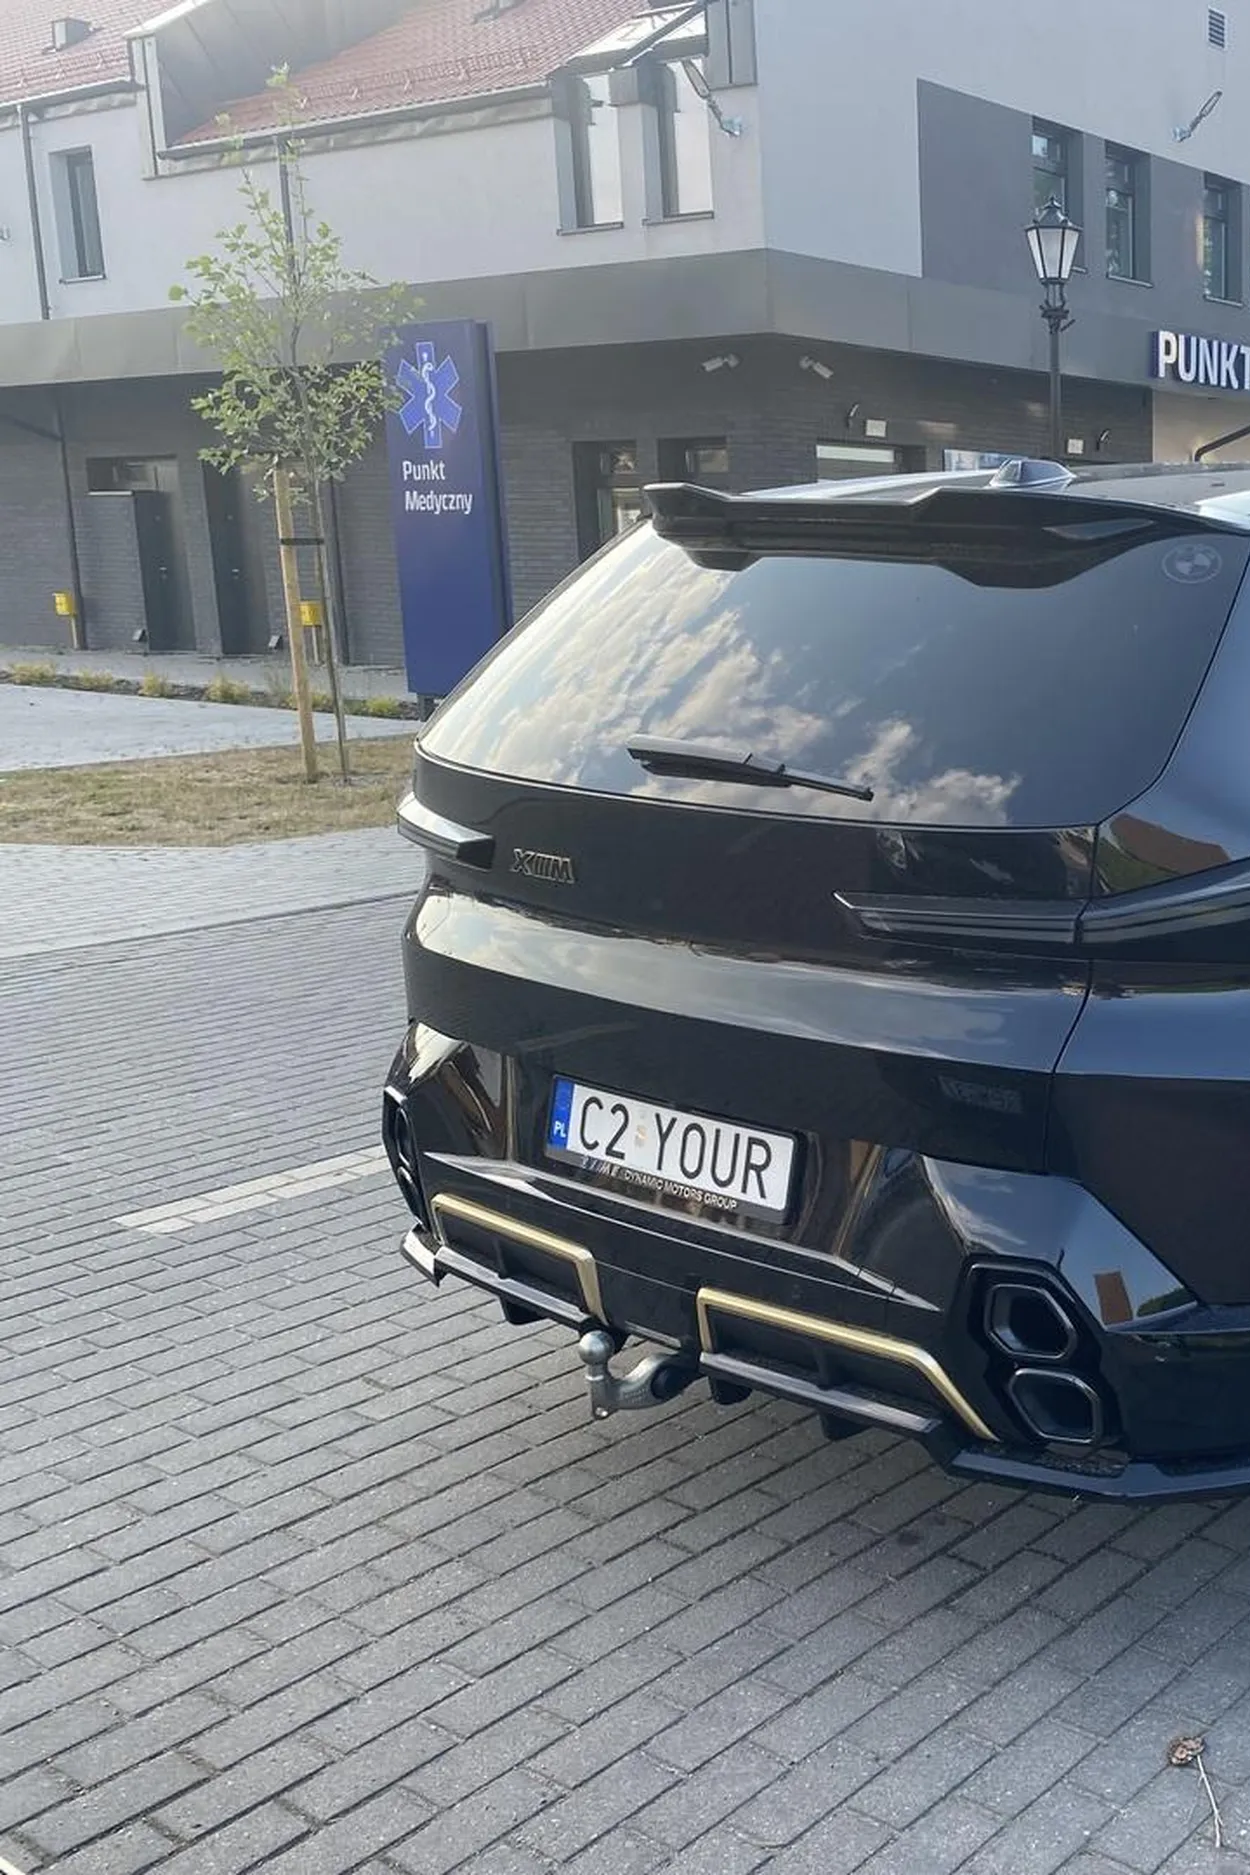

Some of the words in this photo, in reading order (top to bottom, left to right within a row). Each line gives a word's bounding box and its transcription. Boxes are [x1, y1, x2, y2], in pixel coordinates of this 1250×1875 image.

[402, 459, 446, 481] Punkt
[404, 490, 473, 515] Medyczny
[553, 1120, 567, 1138] PL
[579, 1096, 630, 1160] C2
[655, 1112, 772, 1199] YOUR
[624, 1169, 662, 1190] DYNAMIC
[664, 1181, 702, 1202] MOTORS
[703, 1193, 737, 1210] GROUP
